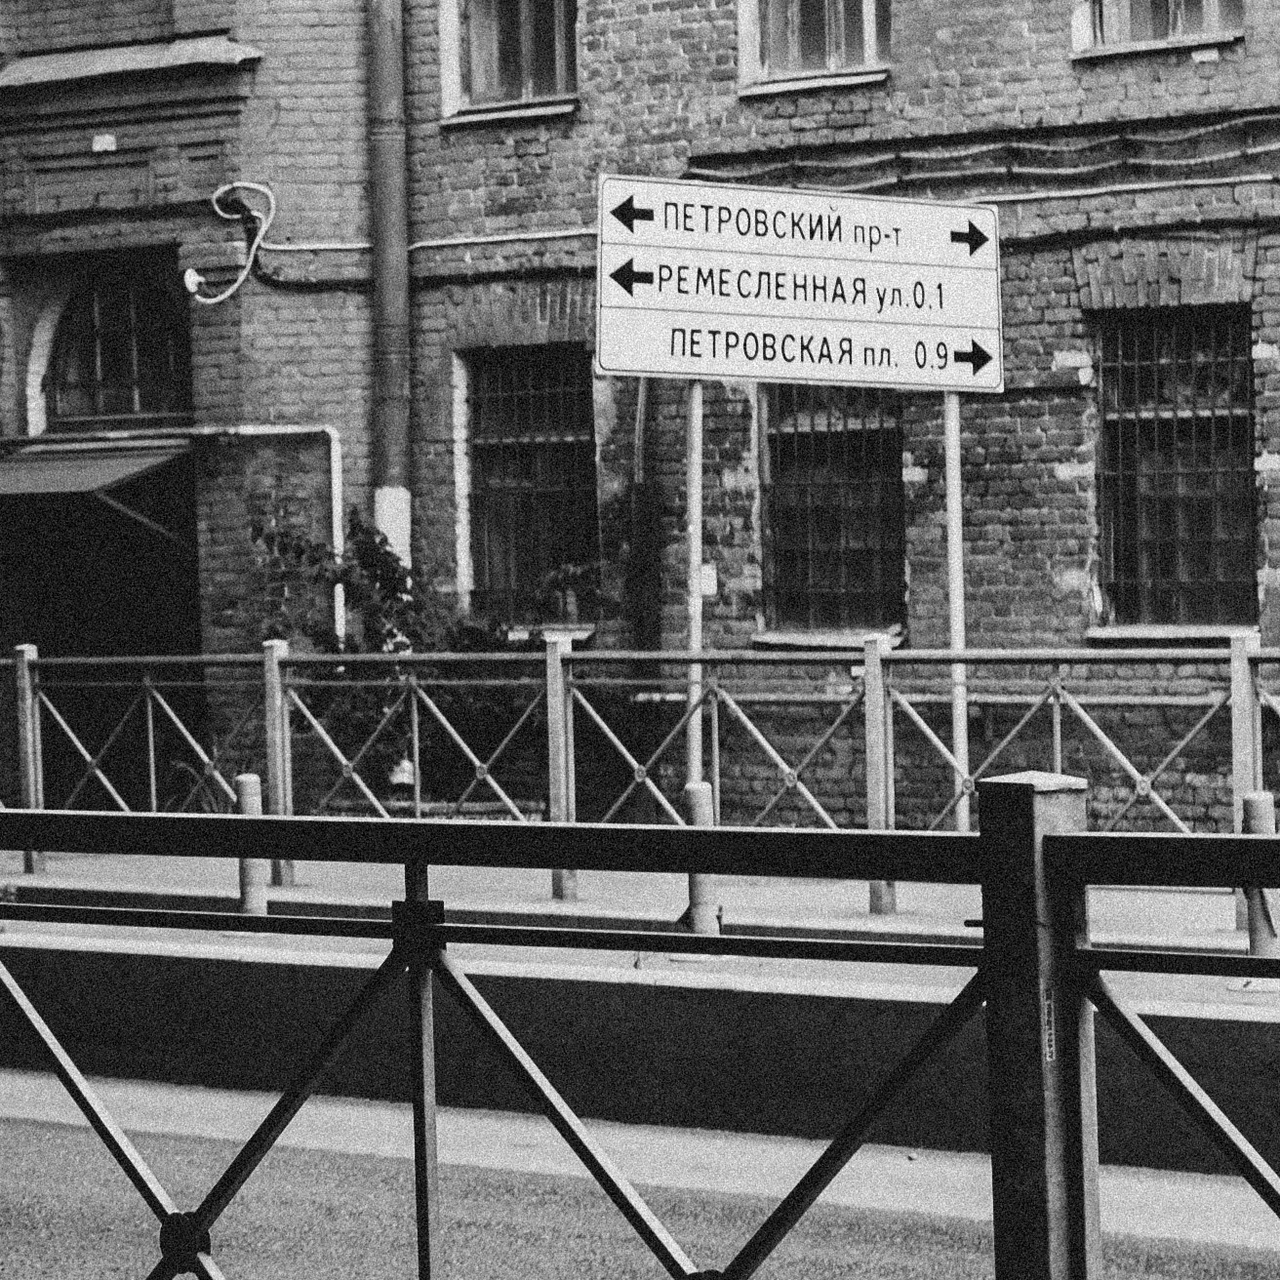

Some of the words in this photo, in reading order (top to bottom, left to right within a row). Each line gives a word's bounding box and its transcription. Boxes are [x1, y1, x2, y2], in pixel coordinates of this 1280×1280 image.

[663, 202, 842, 242] ПЕТРОВСКИЙ
[853, 221, 901, 252] пр-т
[658, 264, 867, 305] РЕМЕСЛЕННАЯ
[670, 328, 853, 365] ПЕТРОВСКАЯ
[863, 348, 899, 368] пл.
[914, 340, 949, 370] 0.9
